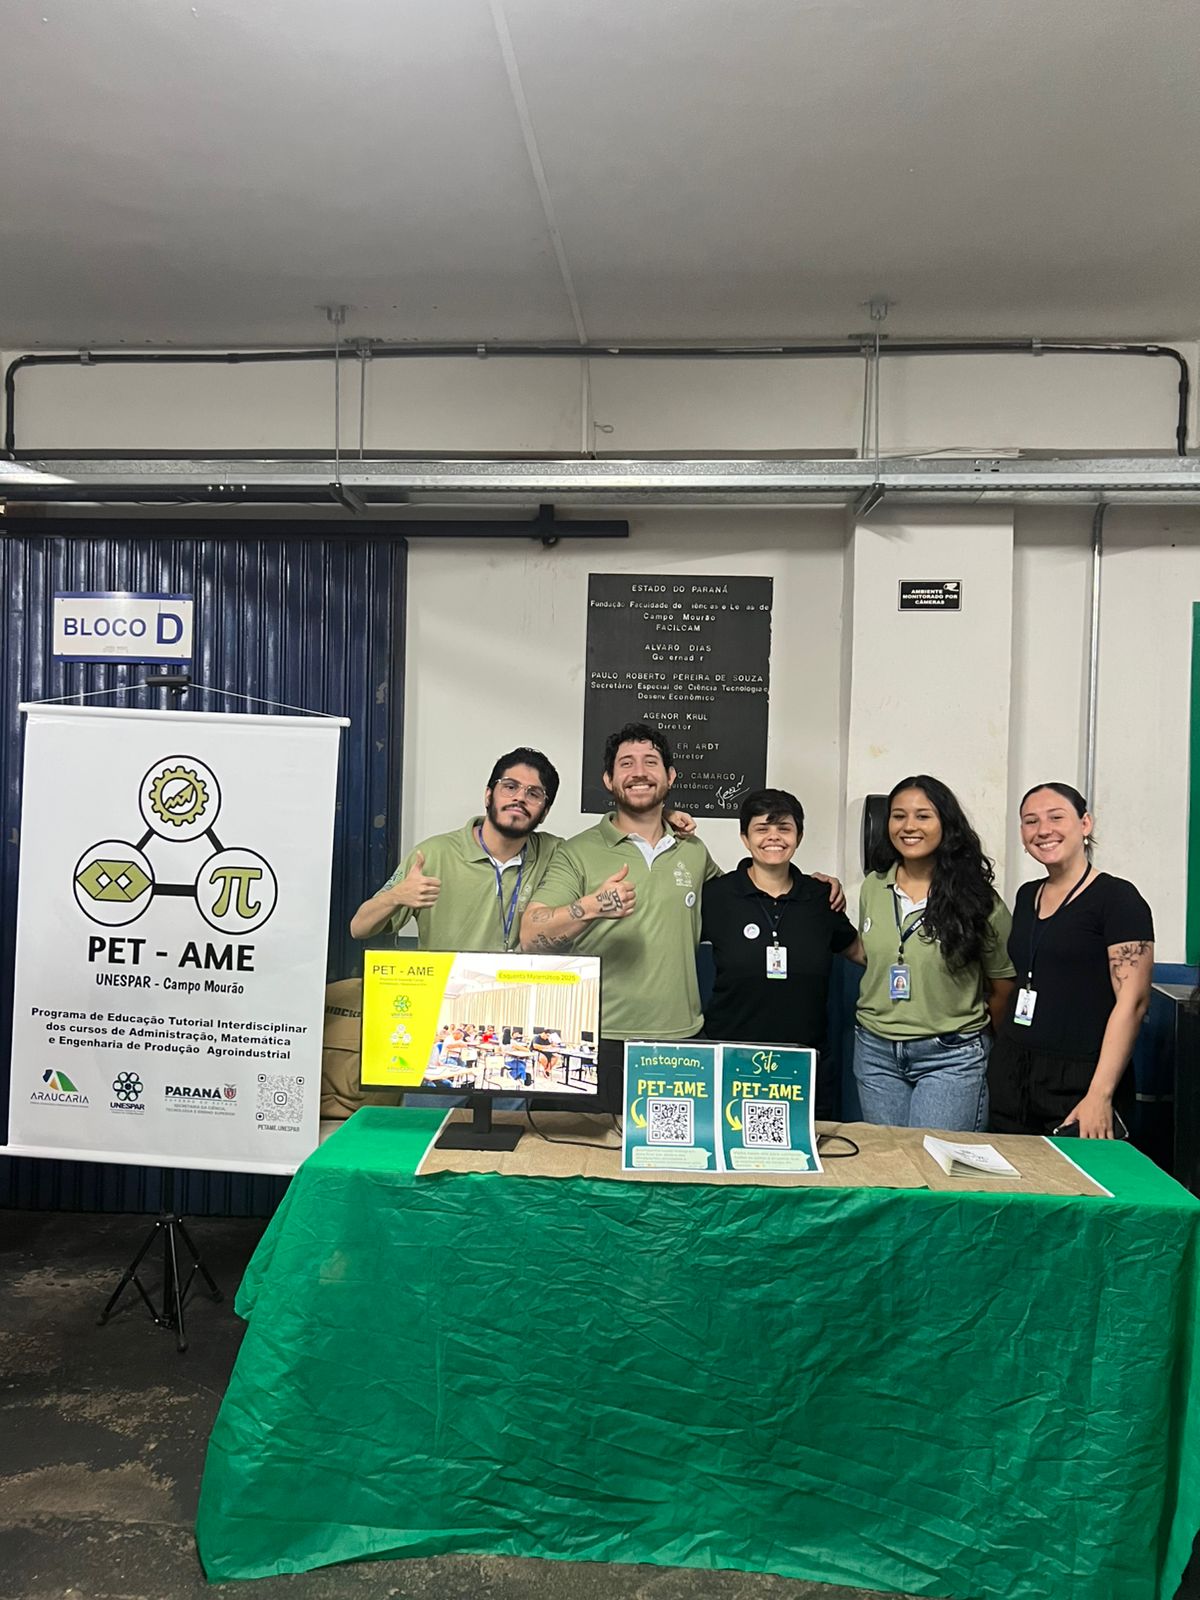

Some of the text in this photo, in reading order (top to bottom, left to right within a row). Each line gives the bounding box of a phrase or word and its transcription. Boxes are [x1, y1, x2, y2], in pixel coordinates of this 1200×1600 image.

[632, 585, 728, 593] ESTADO DO PARANÁ
[759, 603, 769, 611] de
[643, 612, 716, 621] Campo Mourão
[63, 612, 183, 645] BLOCO D
[645, 643, 712, 652] ALVARO DIAS
[591, 672, 763, 682] PAULO ROBERTO PEREIRA DE SOUZA
[590, 681, 633, 690] Secretário
[637, 682, 669, 691] Especial
[673, 683, 683, 691] de
[688, 683, 718, 692] Ciência
[722, 684, 763, 693] Tecnologia
[668, 693, 715, 701] Econômico
[643, 712, 708, 721] AGENOR KRUL
[658, 722, 692, 731] Diretor
[672, 752, 704, 760] Diretor
[691, 772, 736, 781] CAMARGO
[674, 801, 699, 810] Março
[88, 935, 146, 965] PET
[178, 941, 255, 972] AME
[372, 964, 396, 975] PET
[407, 966, 435, 977] AME
[95, 973, 151, 989] UNESPAR
[163, 977, 201, 994] Campo
[204, 980, 244, 995] Mourão
[31, 1007, 308, 1036] Programa de Educação Tutorial Interdisciplinar
[45, 1021, 291, 1046] dos cursos de Administração, Matemática
[48, 1035, 290, 1060] e Engenharia de Produção Agroindustrial
[640, 1056, 701, 1069] Instagram
[752, 1051, 781, 1075] Site
[165, 1085, 222, 1099] PARANÁ
[637, 1079, 709, 1098] PET-AME
[732, 1080, 804, 1101] PET-AME
[110, 1101, 145, 1111] UNESPAR
